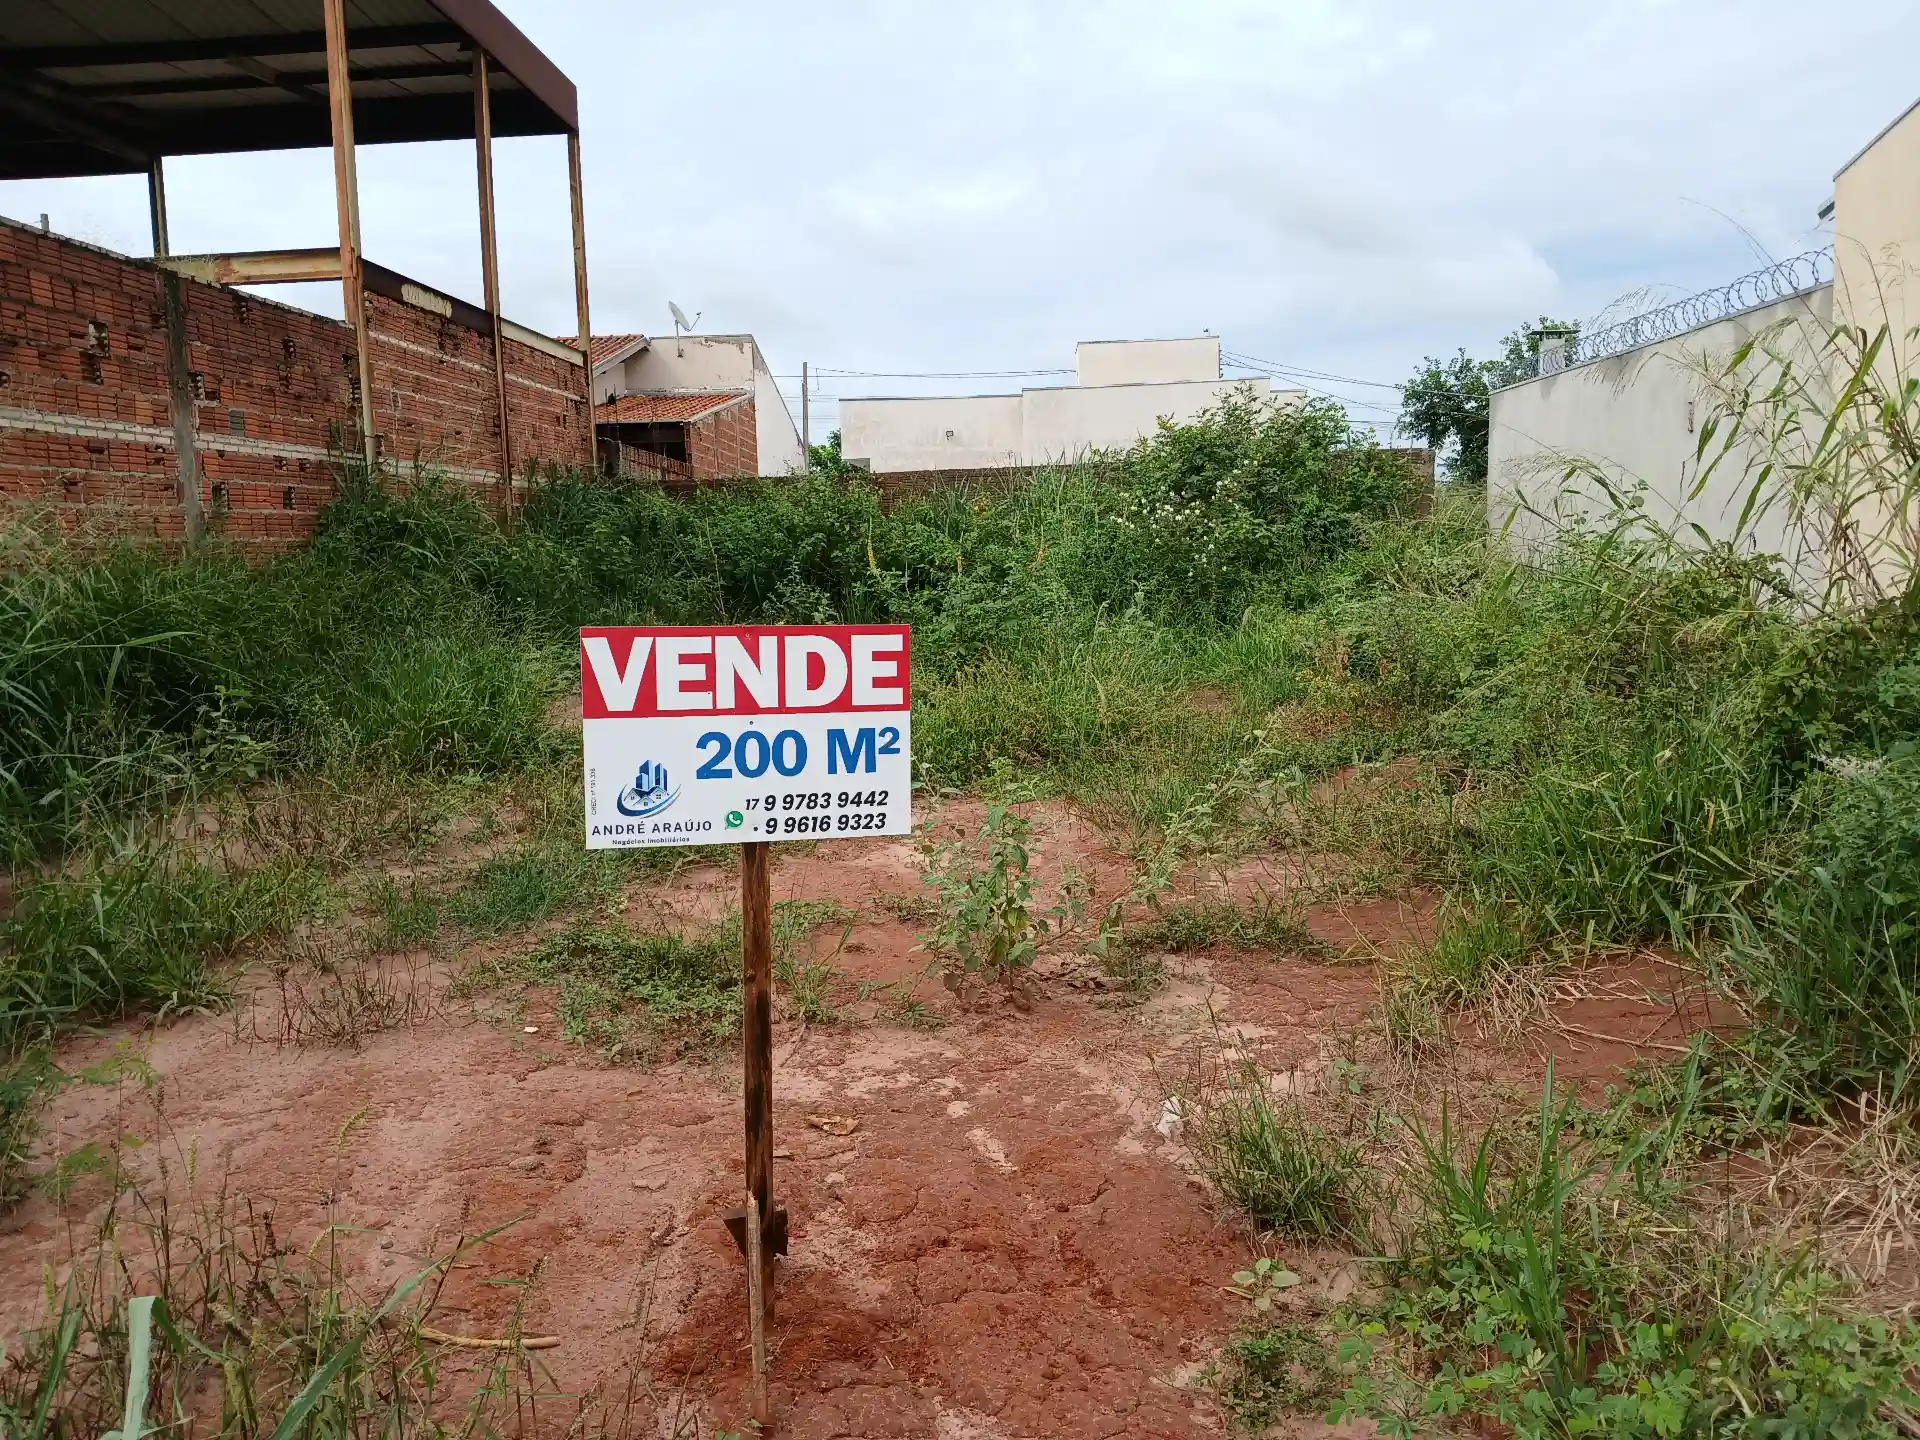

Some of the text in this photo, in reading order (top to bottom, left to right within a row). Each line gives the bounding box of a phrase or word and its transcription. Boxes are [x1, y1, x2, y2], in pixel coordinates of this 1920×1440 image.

[582, 634, 904, 712] VENDE
[696, 729, 808, 779] 200
[746, 789, 889, 811] 17 9 9783 9442
[592, 819, 712, 836] ANDRÉ ARAÚJO
[765, 812, 887, 834] 9 9616 9323
[612, 838, 646, 846] Negócios
